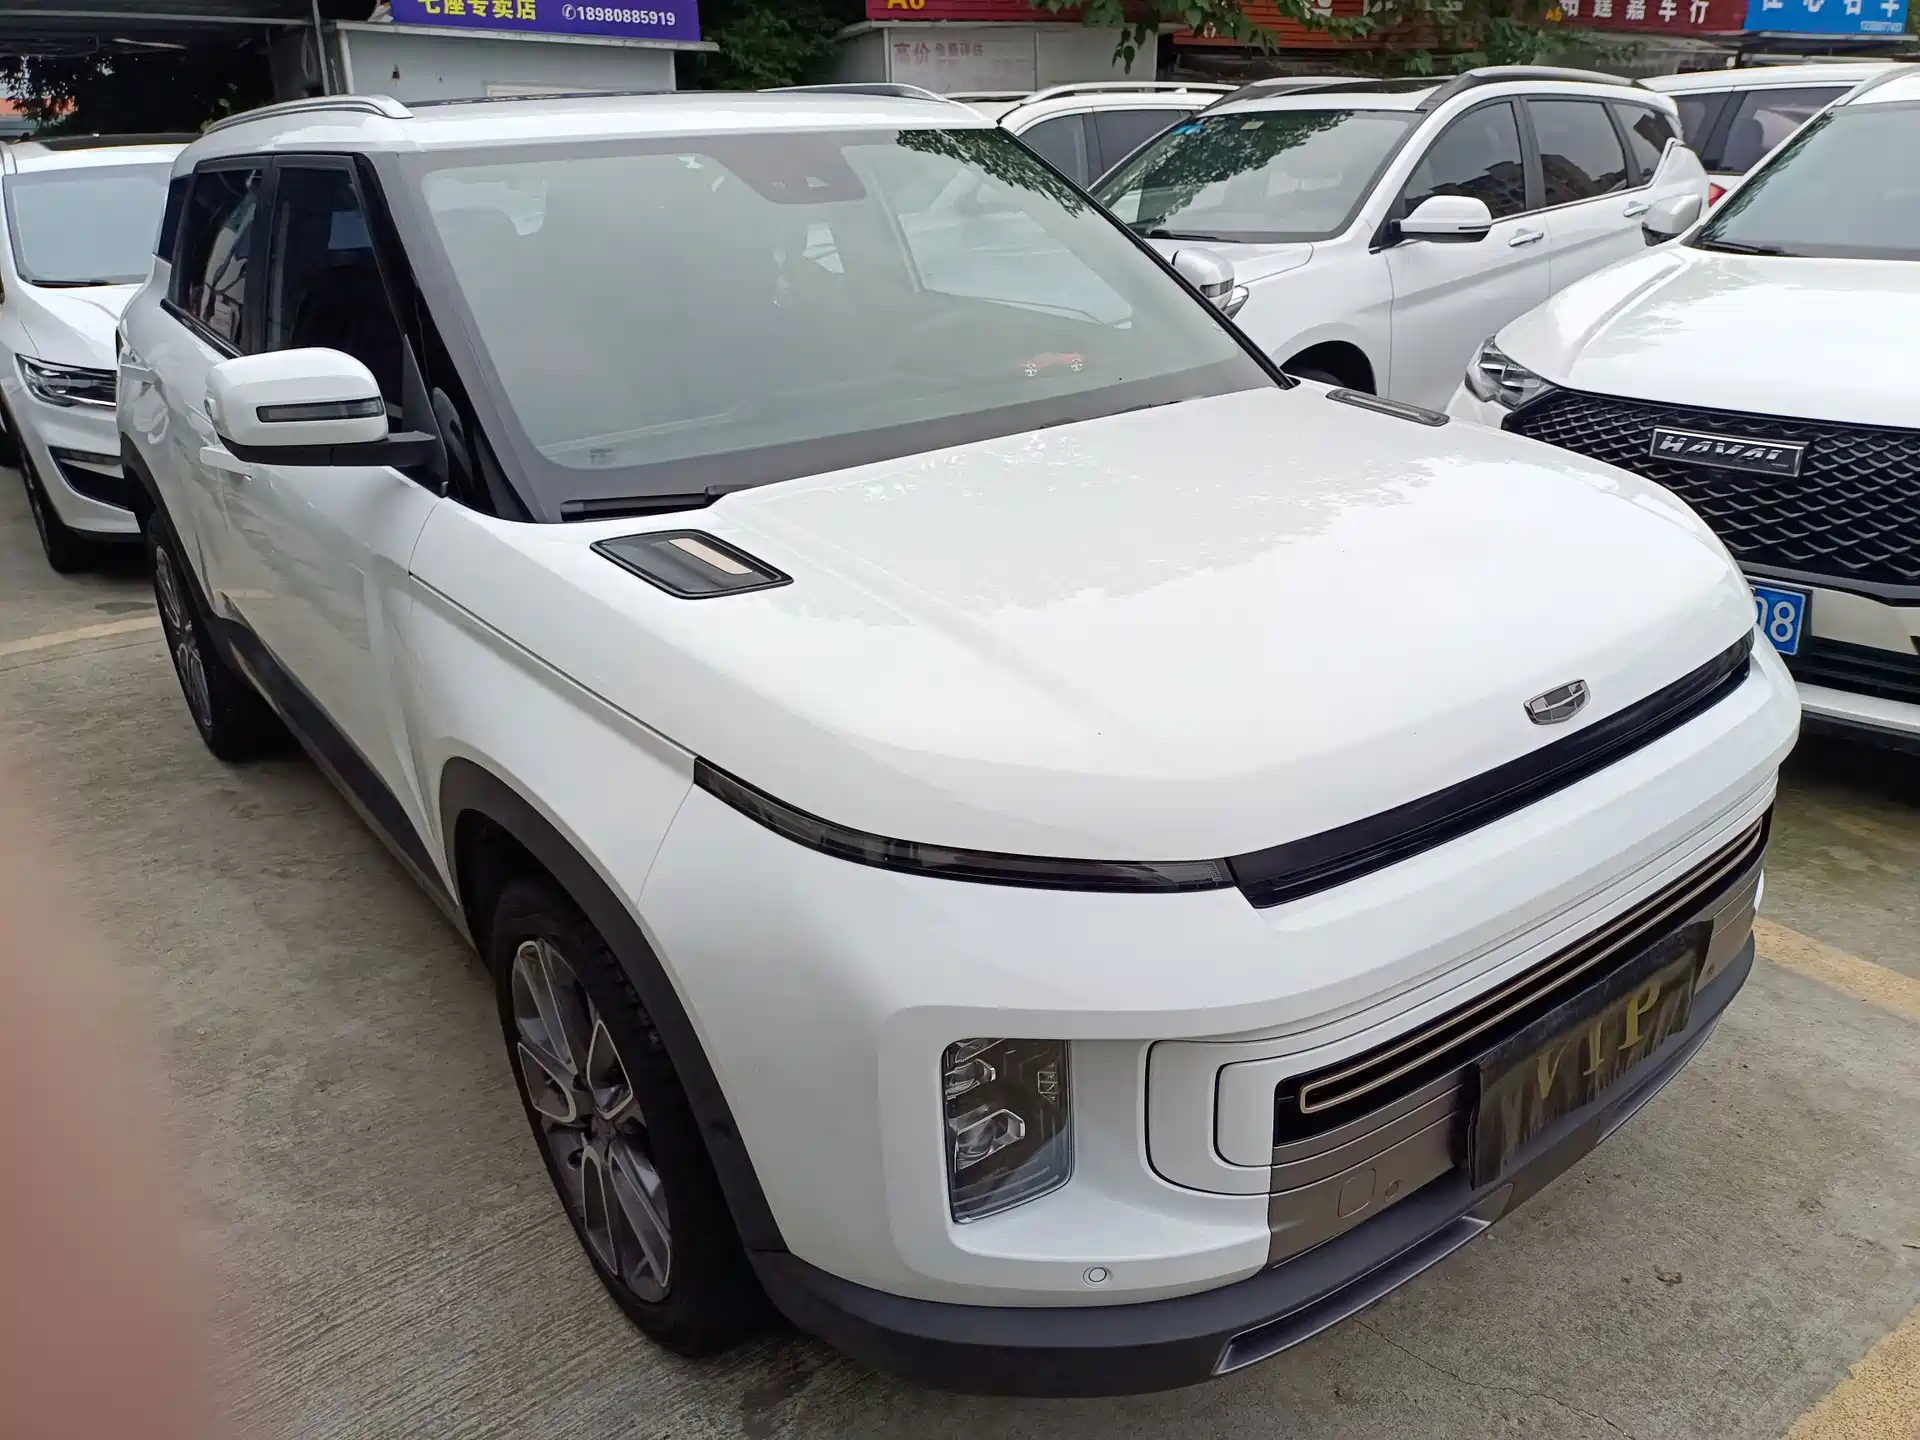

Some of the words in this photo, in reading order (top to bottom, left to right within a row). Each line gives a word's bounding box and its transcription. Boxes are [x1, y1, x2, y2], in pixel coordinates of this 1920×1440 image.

[576, 5, 676, 26] 18980885919
[1658, 435, 1790, 467] HAVAL
[1537, 978, 1661, 1101] VIP
